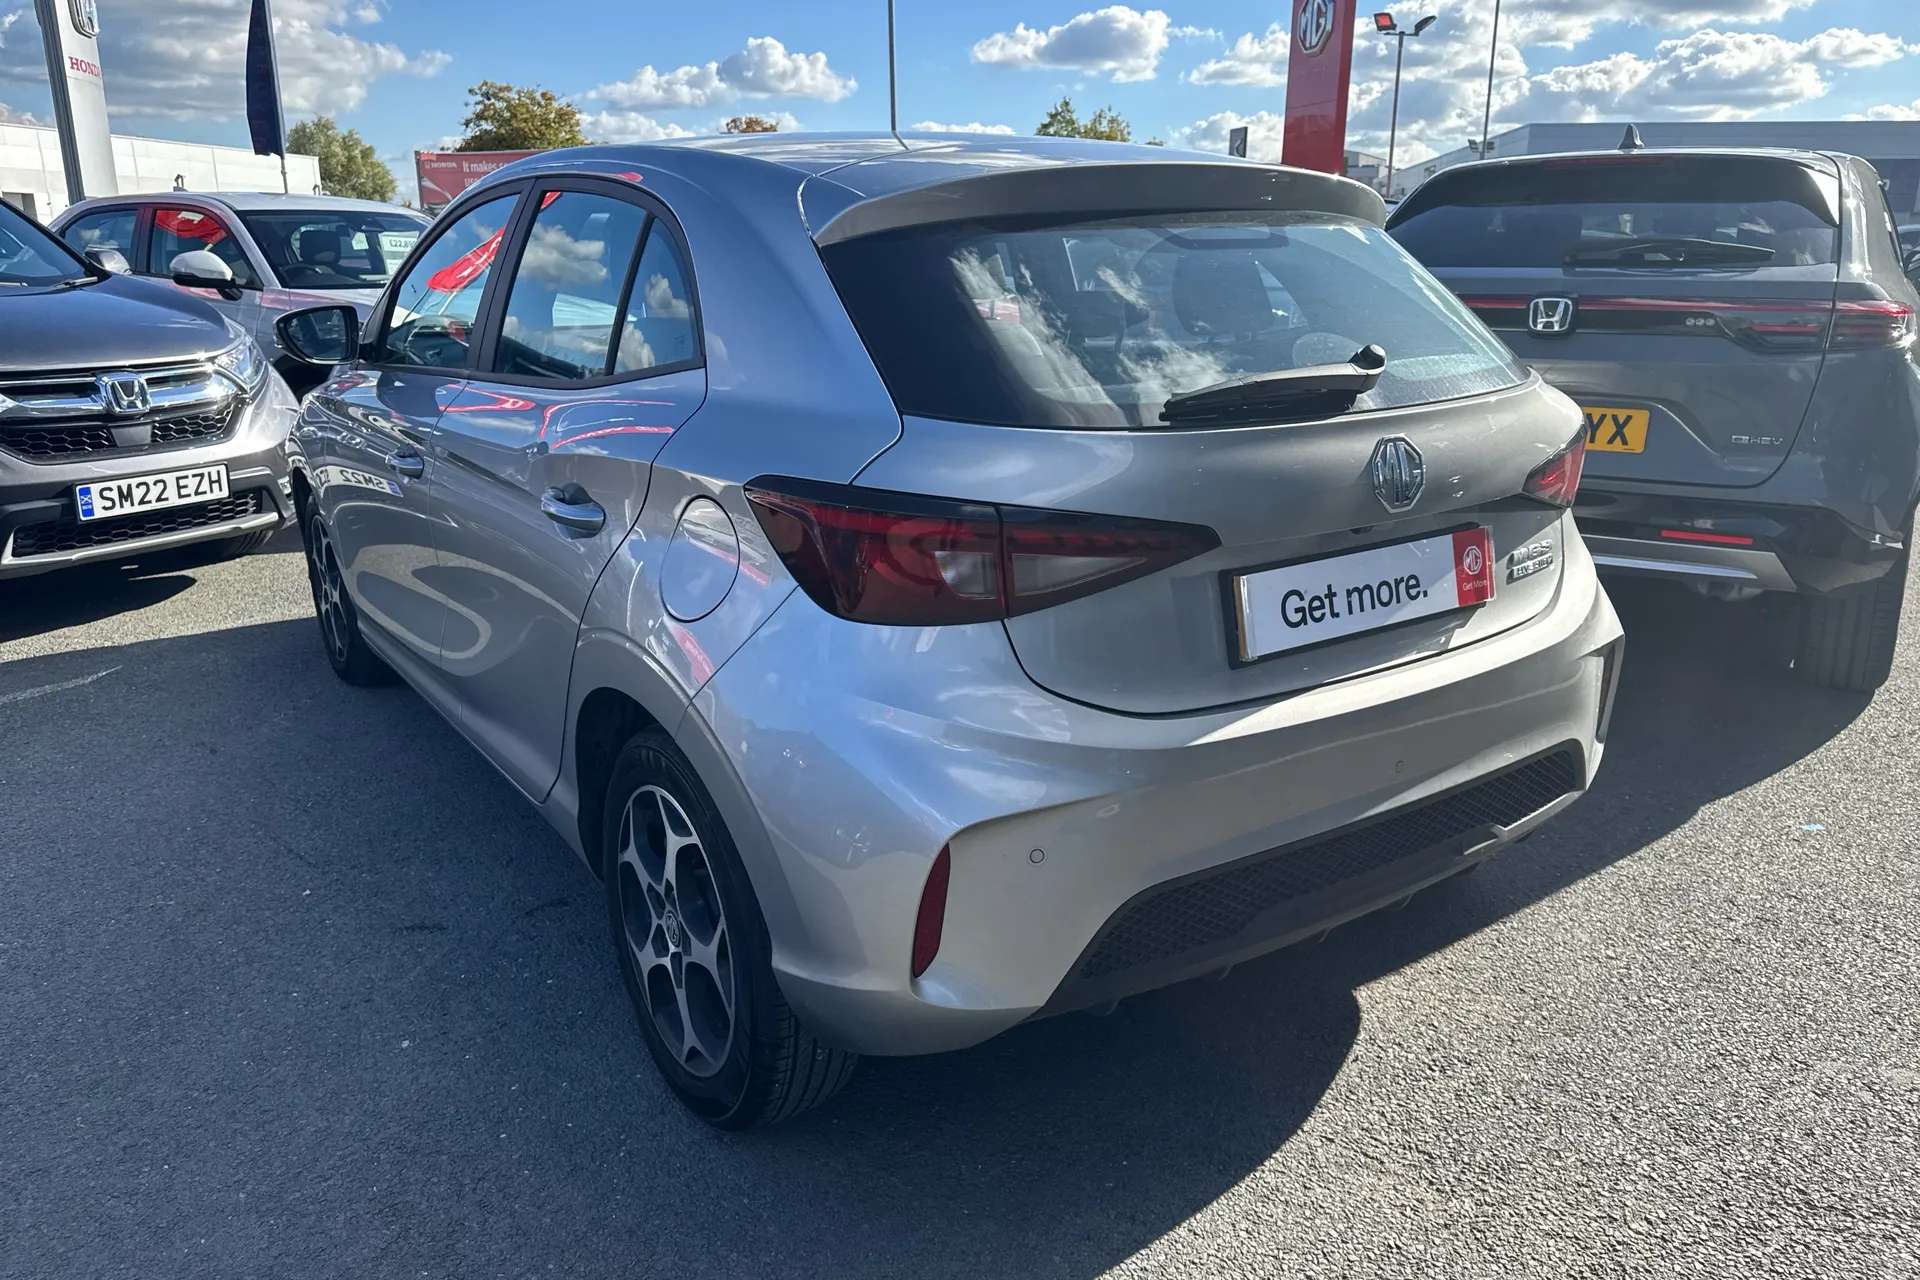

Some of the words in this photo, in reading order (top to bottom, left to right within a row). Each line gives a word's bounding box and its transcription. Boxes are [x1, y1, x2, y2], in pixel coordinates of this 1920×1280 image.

[1586, 413, 1632, 446] YX
[98, 479, 169, 511] SM22
[176, 470, 223, 499] EZH
[1281, 584, 1340, 628] Get
[1346, 574, 1428, 616] more.
[1463, 581, 1473, 591] Get
